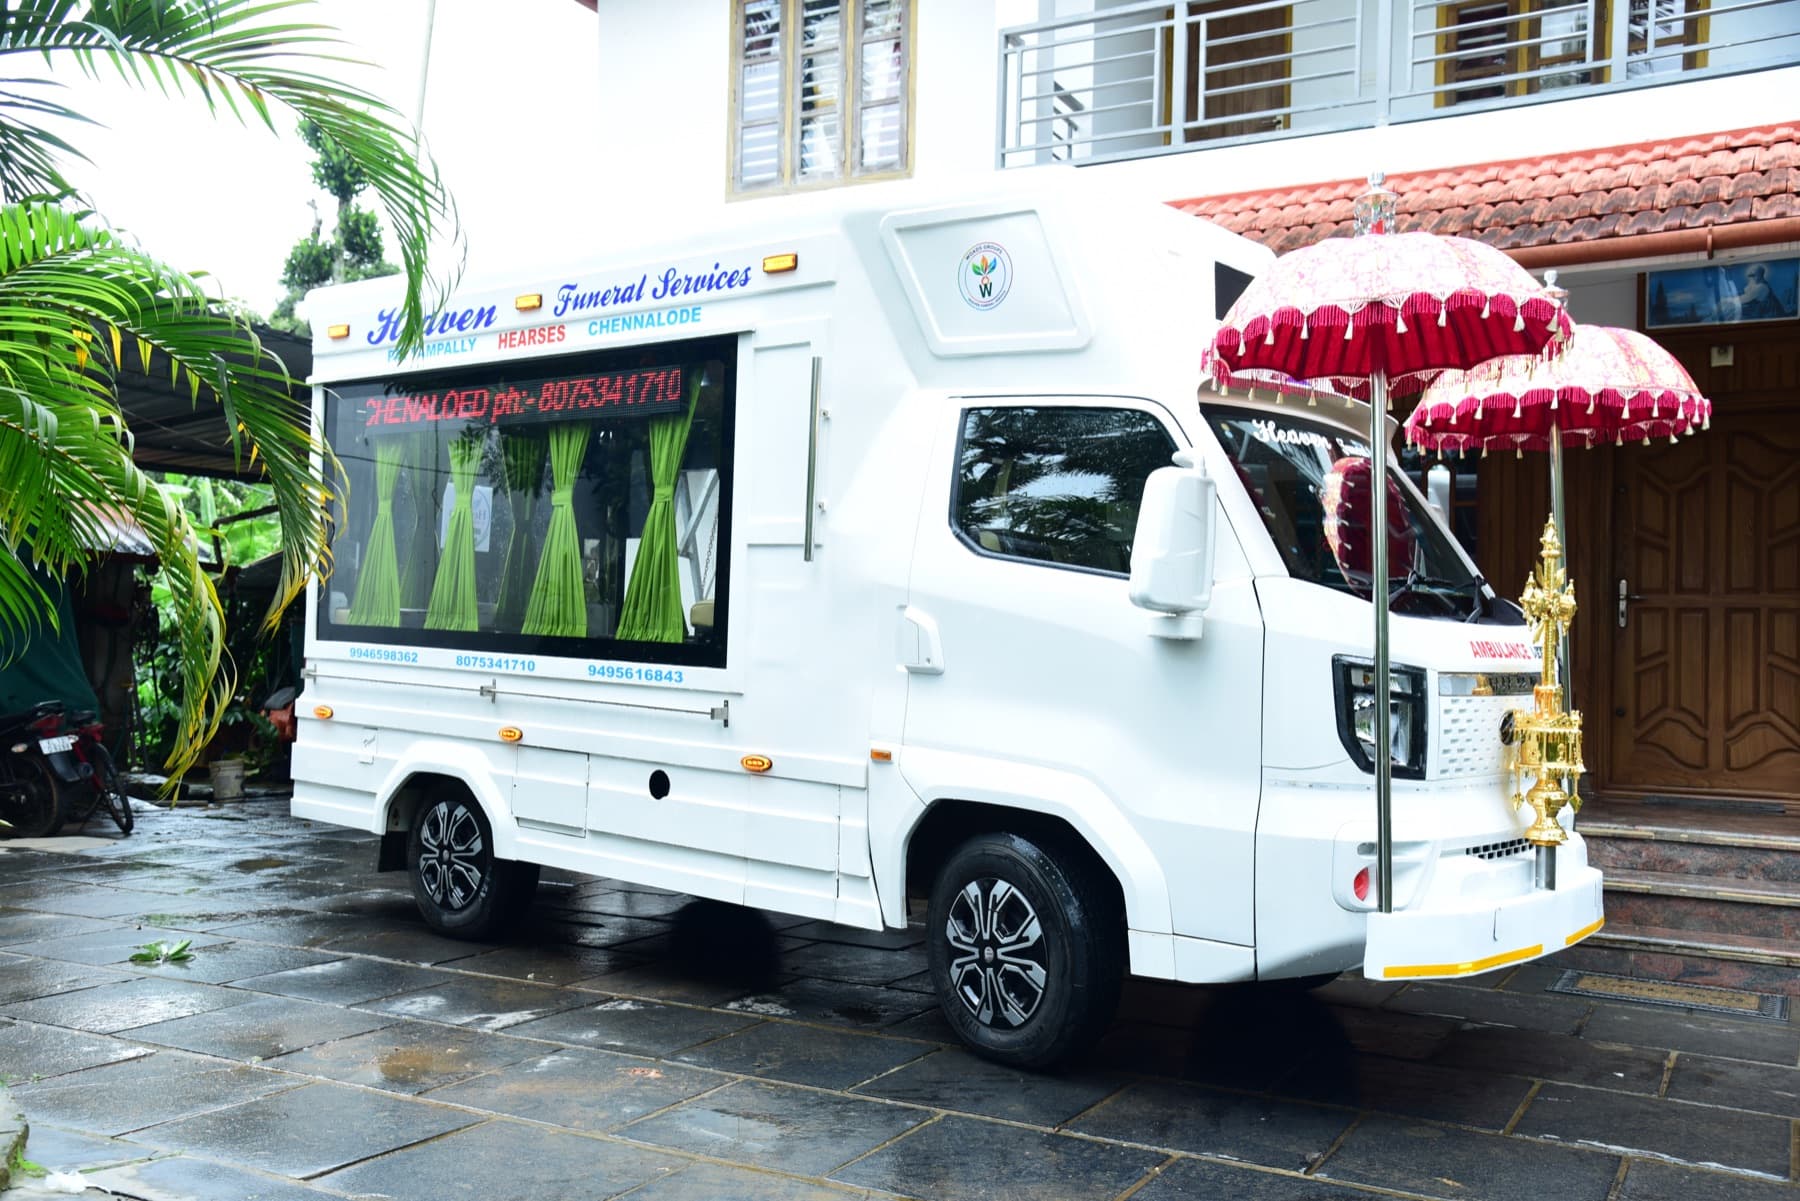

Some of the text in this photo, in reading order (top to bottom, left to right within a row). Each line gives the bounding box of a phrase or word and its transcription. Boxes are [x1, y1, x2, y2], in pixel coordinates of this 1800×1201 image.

[367, 262, 752, 345] Haven Funeral Services
[498, 325, 566, 350] HEARSES
[588, 307, 702, 336] CHENNALODE
[349, 647, 684, 683] 9946598362 8075341710 9495616843
[1470, 641, 1531, 660] AMBULANCE
